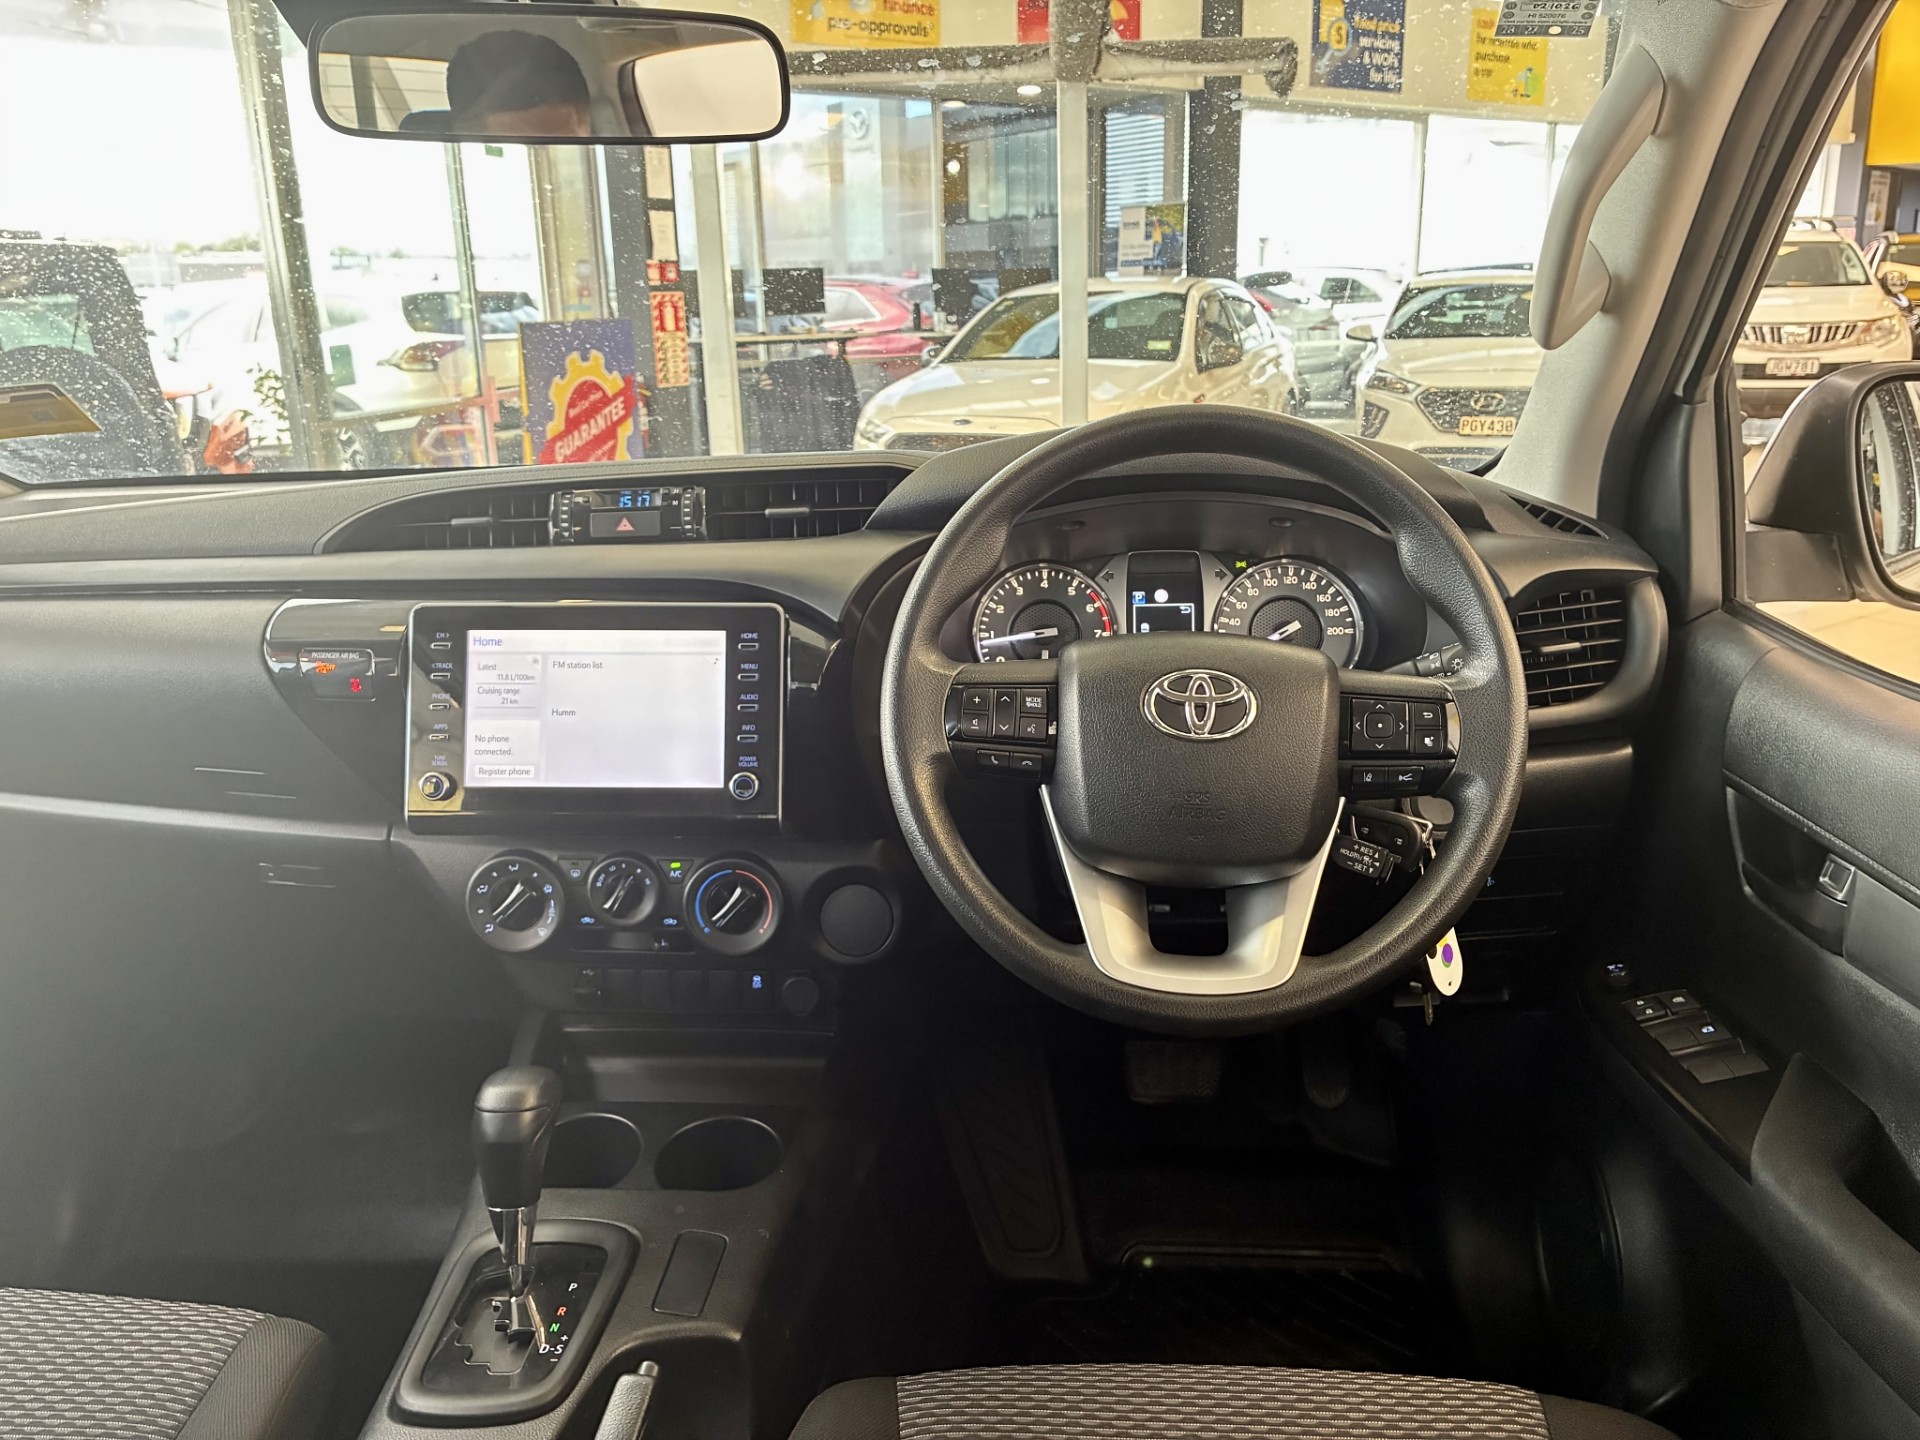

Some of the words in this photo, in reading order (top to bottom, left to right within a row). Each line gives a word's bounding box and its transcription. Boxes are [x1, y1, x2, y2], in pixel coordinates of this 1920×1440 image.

[1524, 26, 1539, 35] 27
[554, 396, 626, 463] GUARANTEE
[1040, 580, 1049, 589] 4
[1263, 578, 1278, 587] 100
[1283, 576, 1298, 584] 120
[1302, 581, 1317, 590] 140
[1016, 587, 1024, 596] 3
[1067, 586, 1076, 596] 5
[1247, 588, 1259, 596] 80
[1316, 594, 1331, 602] 160
[996, 605, 1005, 614] 2
[1085, 603, 1095, 613] 6
[1236, 602, 1248, 610] 60
[1325, 608, 1340, 617] 180
[1229, 618, 1241, 626] 40
[989, 630, 995, 639] 1
[1093, 629, 1102, 638] 7
[1327, 627, 1344, 635] 200
[473, 636, 503, 647] Home
[311, 651, 339, 659] PASSENGER
[477, 663, 497, 671] Latest
[552, 661, 566, 669] FM
[566, 661, 591, 669] station
[592, 661, 603, 669] list
[510, 673, 536, 681] L/100km
[477, 686, 503, 696] Cruising
[503, 687, 521, 696] range
[551, 708, 576, 717] Humm
[474, 735, 486, 743] No
[487, 735, 510, 744] phone
[474, 747, 514, 756] connected.
[478, 767, 507, 777] Register
[508, 767, 531, 776] phone
[1360, 845, 1375, 856] RES
[1353, 862, 1368, 872] SET
[670, 870, 682, 878] A/C
[568, 1282, 578, 1292] P
[556, 1306, 567, 1316] R
[549, 1323, 560, 1332] N
